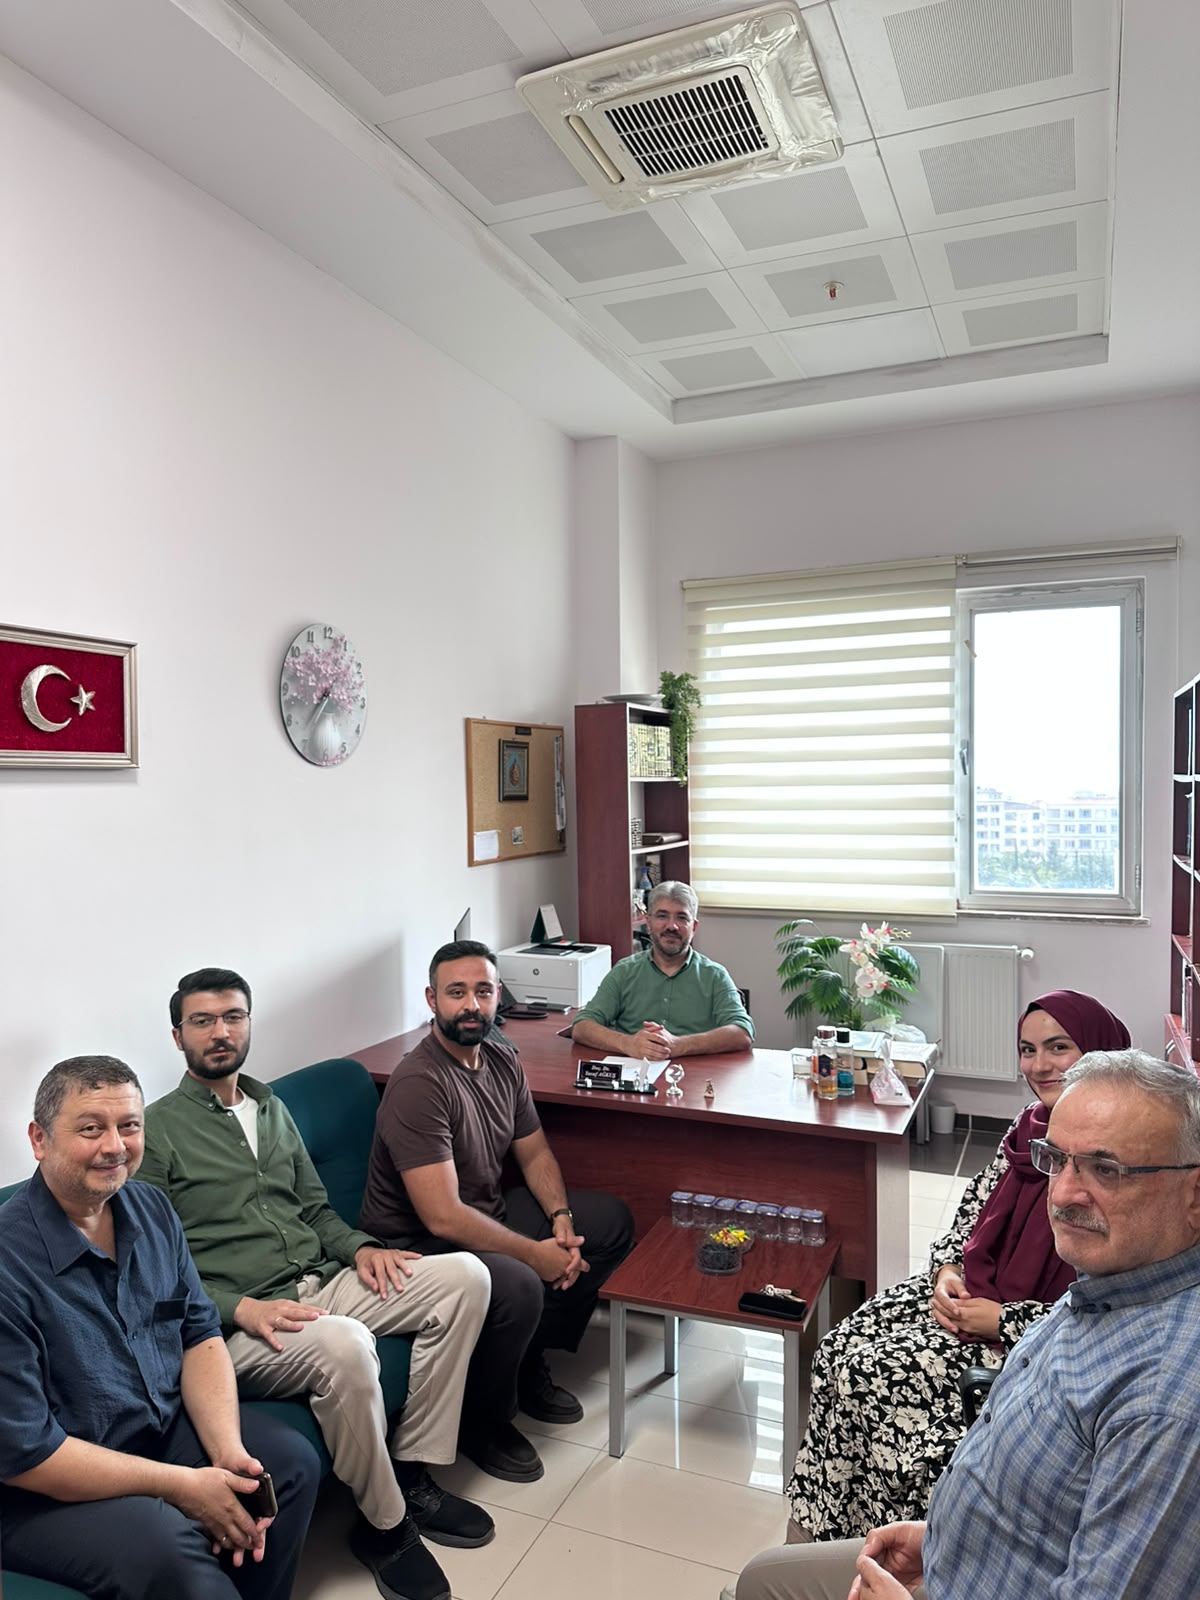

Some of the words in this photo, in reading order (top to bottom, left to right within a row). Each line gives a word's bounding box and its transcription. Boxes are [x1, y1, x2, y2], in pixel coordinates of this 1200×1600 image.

[307, 631, 314, 643] 11
[323, 626, 333, 639] 12
[291, 646, 301, 658] 10
[356, 662, 362, 674] 2
[282, 682, 289, 696] 9
[360, 697, 366, 709] 3
[355, 724, 360, 735] 4
[302, 738, 308, 751] 7
[340, 742, 346, 753] 5
